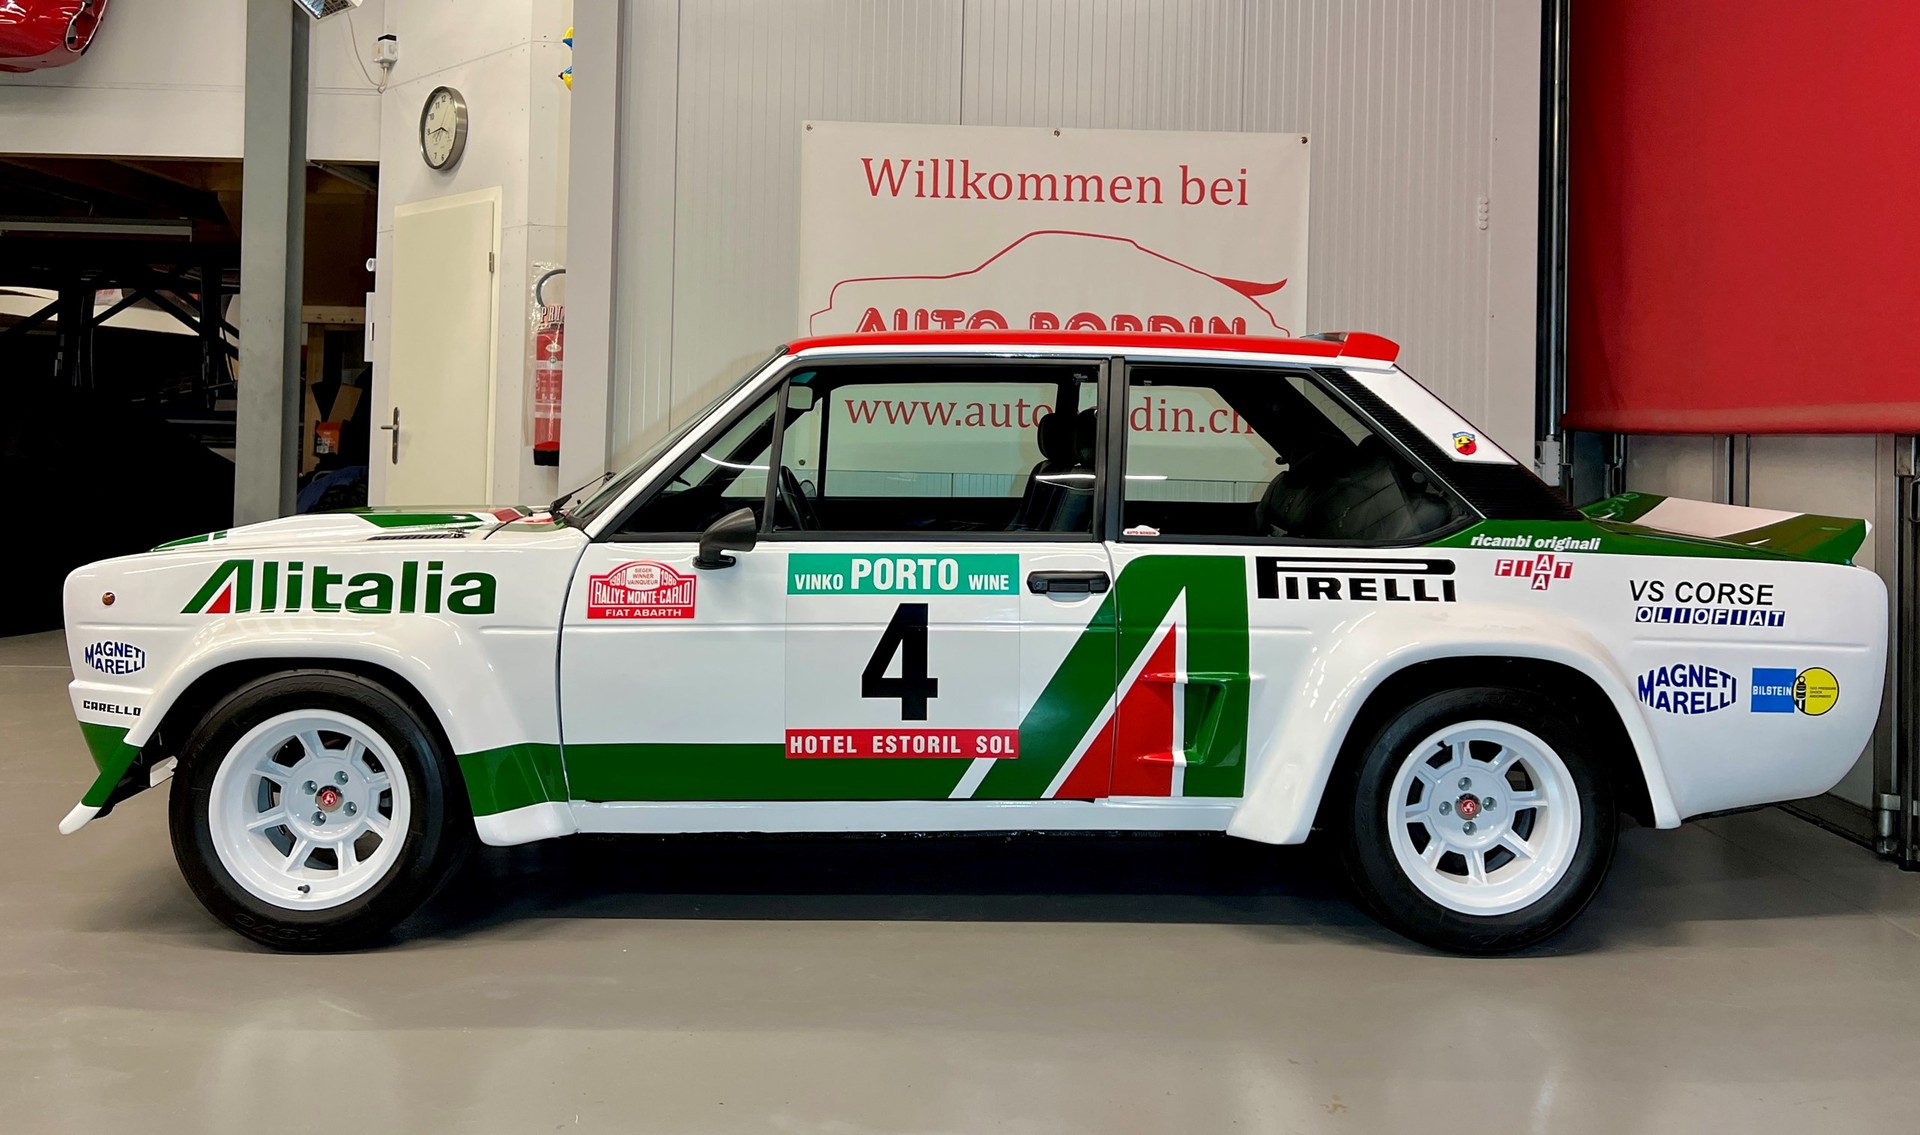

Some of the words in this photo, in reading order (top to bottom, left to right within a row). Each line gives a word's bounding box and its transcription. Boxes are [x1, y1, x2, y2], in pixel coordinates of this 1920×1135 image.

[861, 157, 1164, 204] Willkommen
[1179, 165, 1249, 206] bei
[1470, 534, 1533, 548] ricambi
[1534, 536, 1602, 552] originali
[795, 574, 844, 590] VINKO
[851, 558, 959, 591] PORTO
[968, 575, 1010, 590] WINE
[1497, 555, 1572, 578] FIAT
[179, 559, 497, 615] Alitalia
[1255, 556, 1457, 602] PIRELLI
[594, 582, 625, 604] RALLYE
[627, 582, 691, 604] MONTE-CARLO
[1629, 580, 1665, 602] VS
[1675, 582, 1774, 606] CORSE
[605, 609, 631, 617] FIAT
[633, 609, 682, 617] ABARTH
[1635, 607, 1786, 626] OLIOFIAT
[85, 641, 145, 665] MAGNETI
[85, 650, 145, 674] MARELLI
[861, 603, 938, 720] 4
[1638, 664, 1737, 697] MAGNETI
[1752, 685, 1792, 696] BILSTEIN
[83, 700, 141, 716] CARELLO
[1638, 681, 1737, 715] MARELLI
[790, 736, 857, 754] HOTEL
[872, 736, 961, 754] ESTORIL
[975, 736, 1015, 754] SOL
